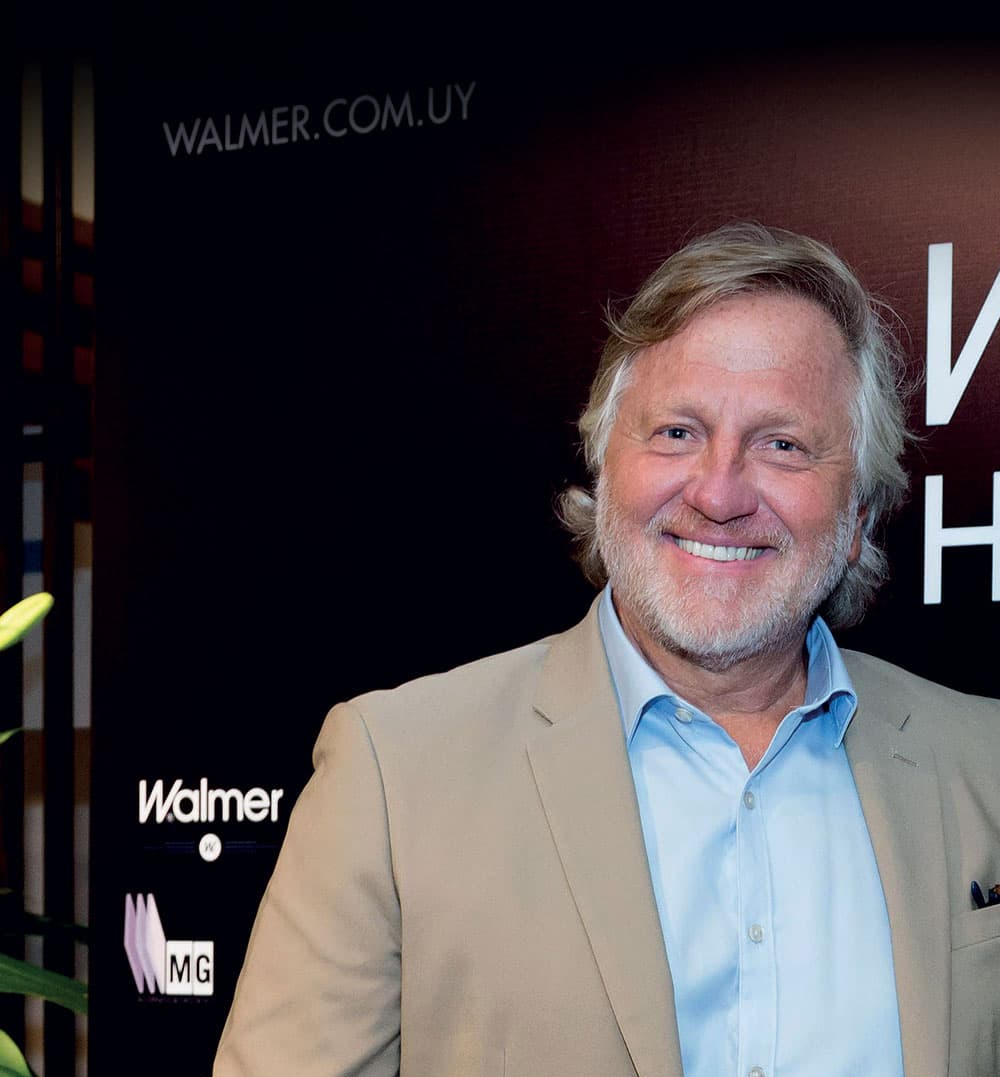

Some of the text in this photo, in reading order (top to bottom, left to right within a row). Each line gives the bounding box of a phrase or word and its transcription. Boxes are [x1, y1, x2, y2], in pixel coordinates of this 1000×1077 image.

[162, 80, 477, 157] WALMER.COM.UY
[138, 776, 285, 825] Walmer
[169, 955, 211, 983] MG
